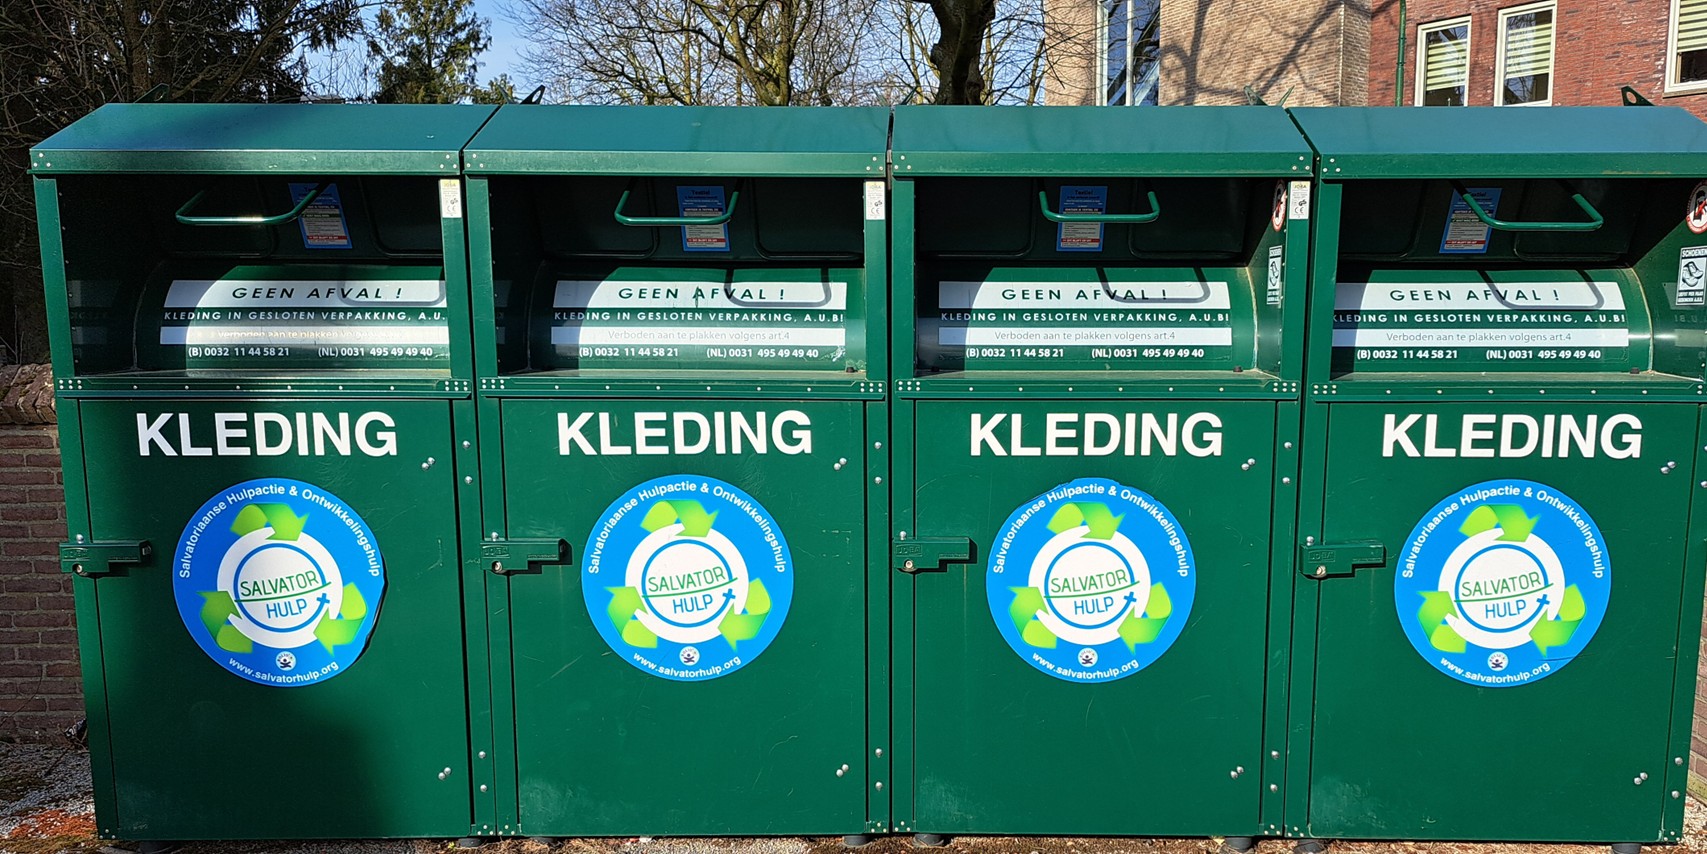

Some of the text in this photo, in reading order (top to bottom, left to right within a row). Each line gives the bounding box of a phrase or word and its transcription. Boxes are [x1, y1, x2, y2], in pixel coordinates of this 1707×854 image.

[232, 287, 402, 299] GEEN AFVAL !
[618, 286, 785, 300] GEEN AFVAL !
[1001, 289, 1167, 300] GEEN AFVAL !
[1389, 289, 1559, 301] GEEN AFVAL !
[164, 311, 221, 320] KLEDING
[228, 311, 241, 320] IN
[248, 311, 315, 320] GESLOTEN
[321, 311, 411, 321] VERPAKKING,
[554, 312, 844, 322] KLEDING IN GESLOTEN VERPAKKING, A.U.B!
[941, 312, 1229, 322] KLEDING IN GESLOTEN VERPAKKING, A.U.B!
[1394, 314, 1408, 322] IN
[1414, 314, 1481, 322] GESLOTEN
[1487, 314, 1578, 323] VERPAKKING,
[1584, 314, 1626, 322] A.U.B!
[608, 331, 655, 339] Verboden
[689, 331, 727, 341] plakken
[728, 331, 766, 341] volgens
[768, 331, 790, 340] art.4
[995, 331, 1041, 340] Verboden
[1063, 332, 1072, 340] te
[1074, 331, 1112, 341] plakken
[1114, 331, 1152, 341] volgens
[1153, 332, 1175, 340] art.4
[1386, 332, 1433, 341] Verboden
[1456, 333, 1467, 341] te
[1468, 332, 1507, 342] plakken
[1509, 332, 1547, 342] volgens
[1549, 333, 1572, 341] art.4
[188, 347, 289, 357] (B) 0032 11 44 58 21
[318, 347, 433, 357] (NL) 0031 495 49 49 40
[579, 347, 678, 357] (B) 0032 11 44 58 21
[706, 348, 819, 358] (NL) 0031 495 49 49 40
[966, 348, 1064, 358] (B) 0032 11 44 58 21
[1091, 348, 1204, 358] (NL) 0031 495 49 49 40
[1357, 349, 1457, 359] (B) 0032 11 44 58 21
[1486, 349, 1601, 359] (NL) 0031 495 49 49 40
[136, 411, 397, 457] KLEDING
[557, 410, 812, 455] KLEDING
[970, 412, 1223, 457] KLEDING
[1382, 413, 1643, 459] KLEDING
[179, 484, 380, 578] Salvatoriaanse Hulpactie & Ontwikkelingshulp
[588, 481, 787, 574] Salvatoriaanse Hulpactie & Ontwikkelingshulp
[993, 483, 1189, 577] Salvatoriaanse Hulpactie & Ontwikkelingshulp
[1402, 485, 1604, 579] Salvatoriaanse Hulpactie & Ontwikkelingshulp
[240, 570, 319, 597] SALVATOR
[648, 566, 726, 592] SALVATOR
[1050, 569, 1128, 593] SALVATOR
[1461, 571, 1541, 597] SALVATOR
[266, 598, 307, 619] HULP
[672, 593, 713, 614] HULP
[1074, 596, 1114, 615] HULP
[1485, 599, 1526, 619] HULP
[228, 657, 339, 683] www.salvatorhulp.org
[633, 653, 741, 678] www.salvatorhulp.org
[1032, 653, 1139, 679] www.salvatorhulp.org
[1440, 657, 1550, 684] www.salvatorhulp.org
